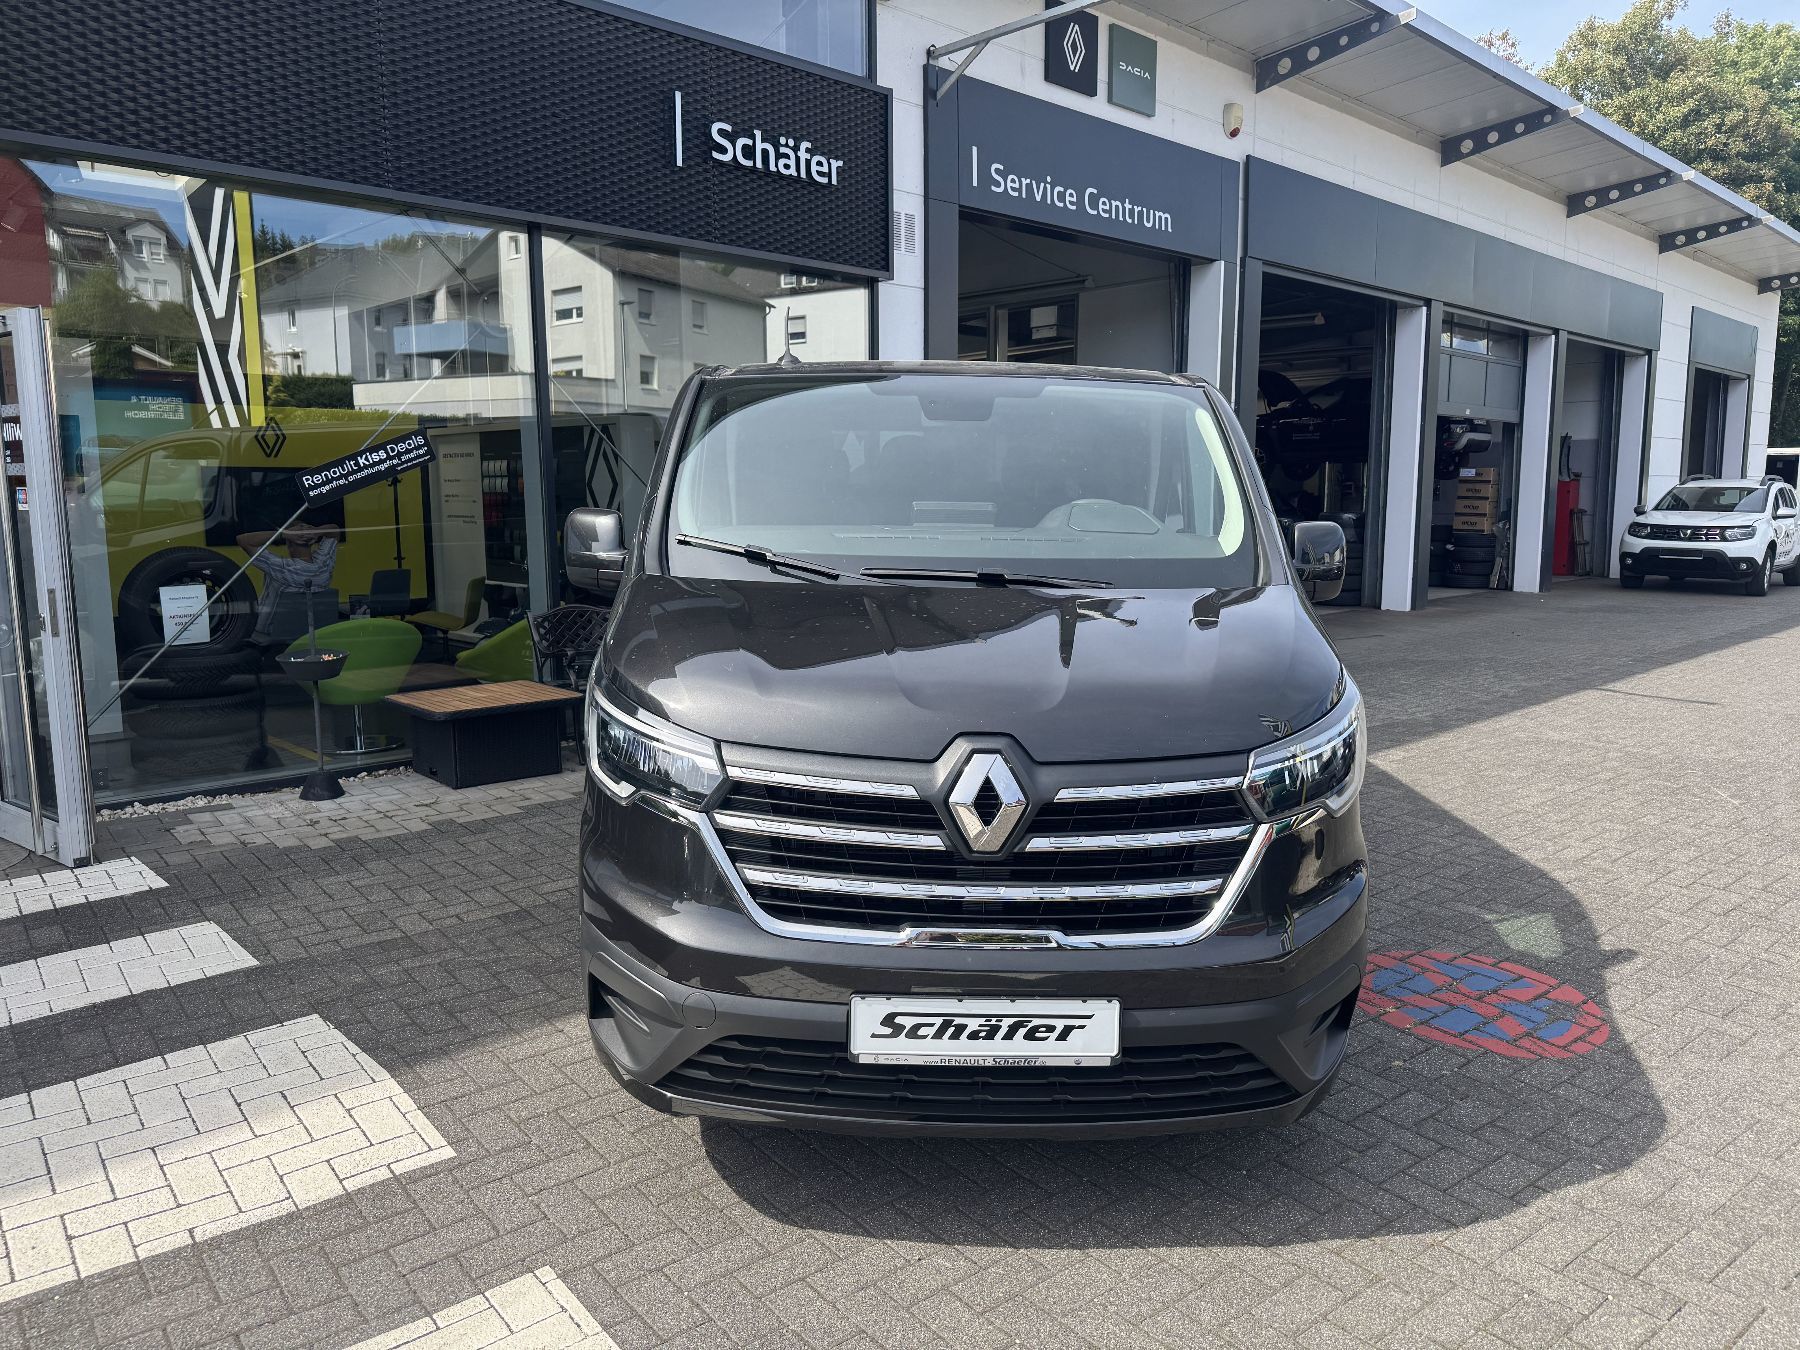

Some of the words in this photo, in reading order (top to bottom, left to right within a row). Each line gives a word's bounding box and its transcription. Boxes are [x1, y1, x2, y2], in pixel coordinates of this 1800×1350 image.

[1119, 61, 1151, 80] DACIA
[710, 121, 844, 186] Schäfer
[990, 163, 1077, 210] Service
[1084, 187, 1173, 233] Centrum
[302, 460, 359, 488] Renault
[357, 449, 387, 467] Kiss
[386, 435, 425, 456] Deals
[869, 1011, 1096, 1042] Schäfer
